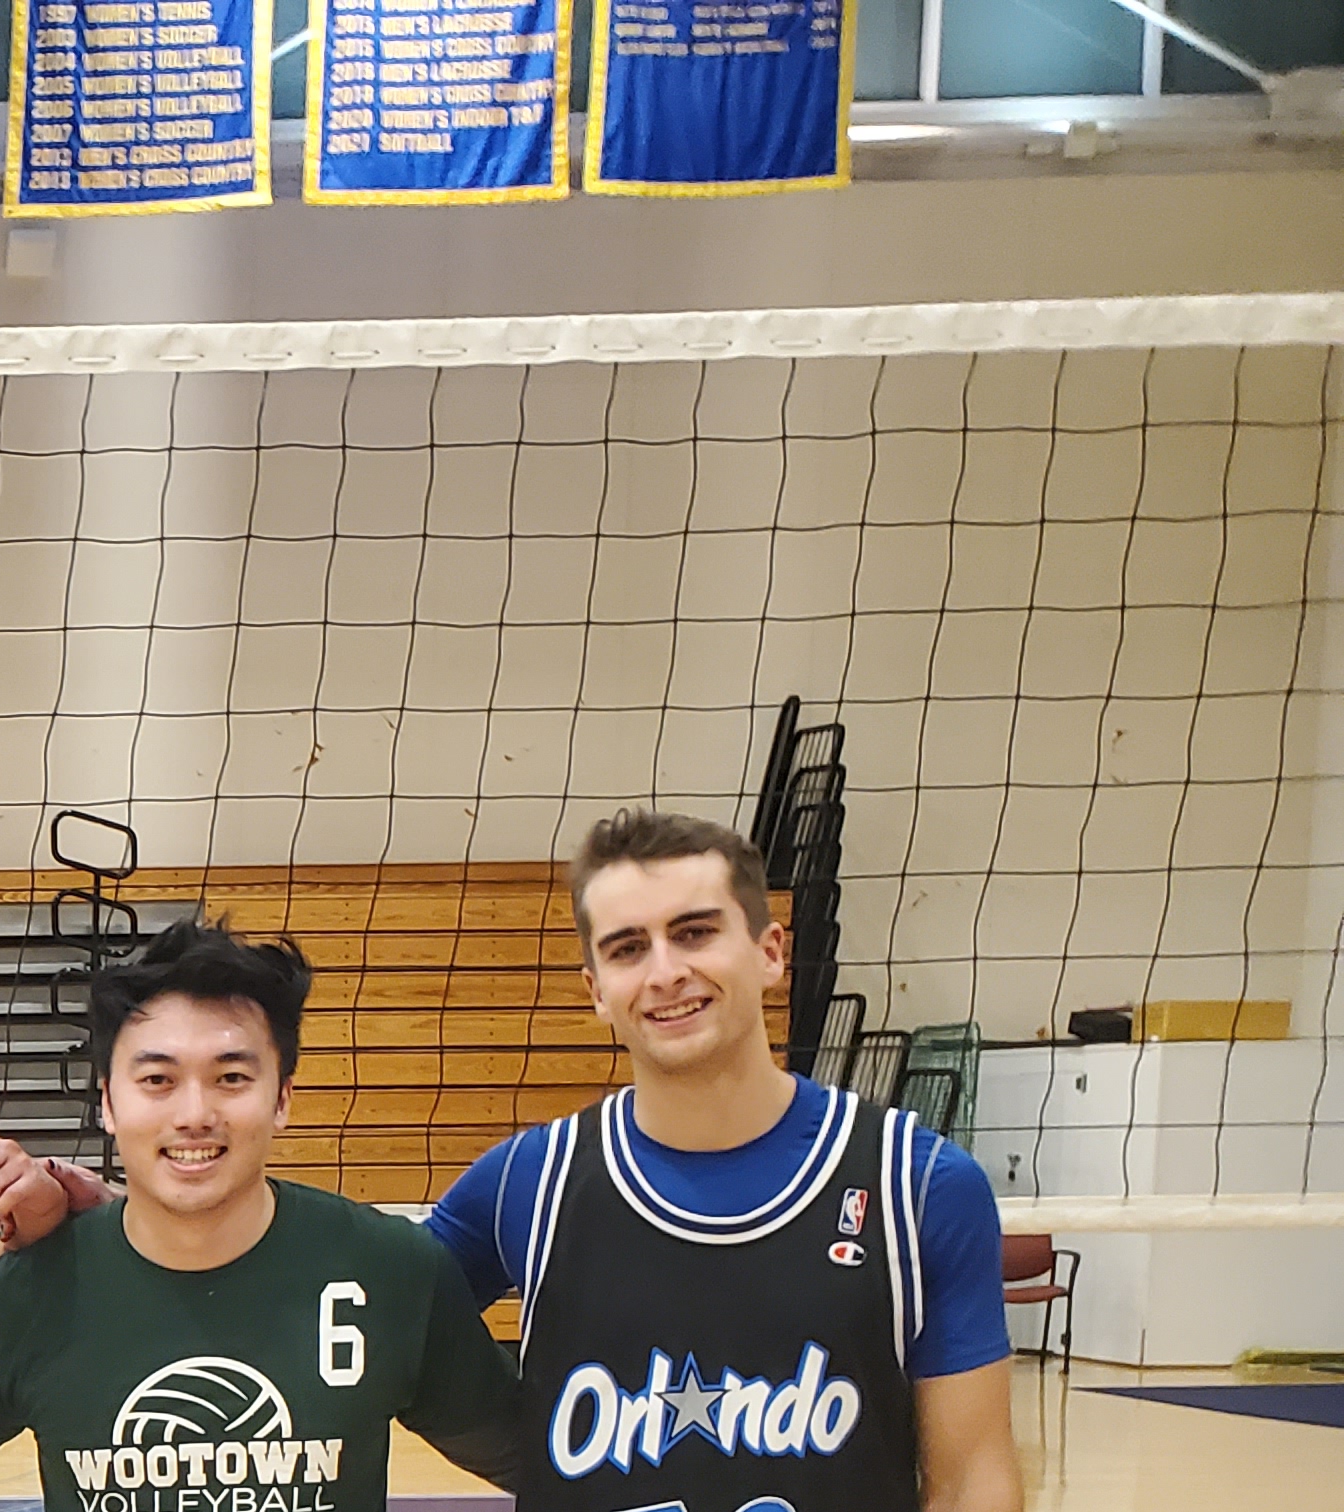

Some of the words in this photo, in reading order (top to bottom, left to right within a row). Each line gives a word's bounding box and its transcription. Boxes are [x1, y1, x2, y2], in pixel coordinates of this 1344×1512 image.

[318, 1281, 366, 1387] 6
[548, 1340, 862, 1480] Orlndo
[65, 1438, 342, 1490] WOOTOWN
